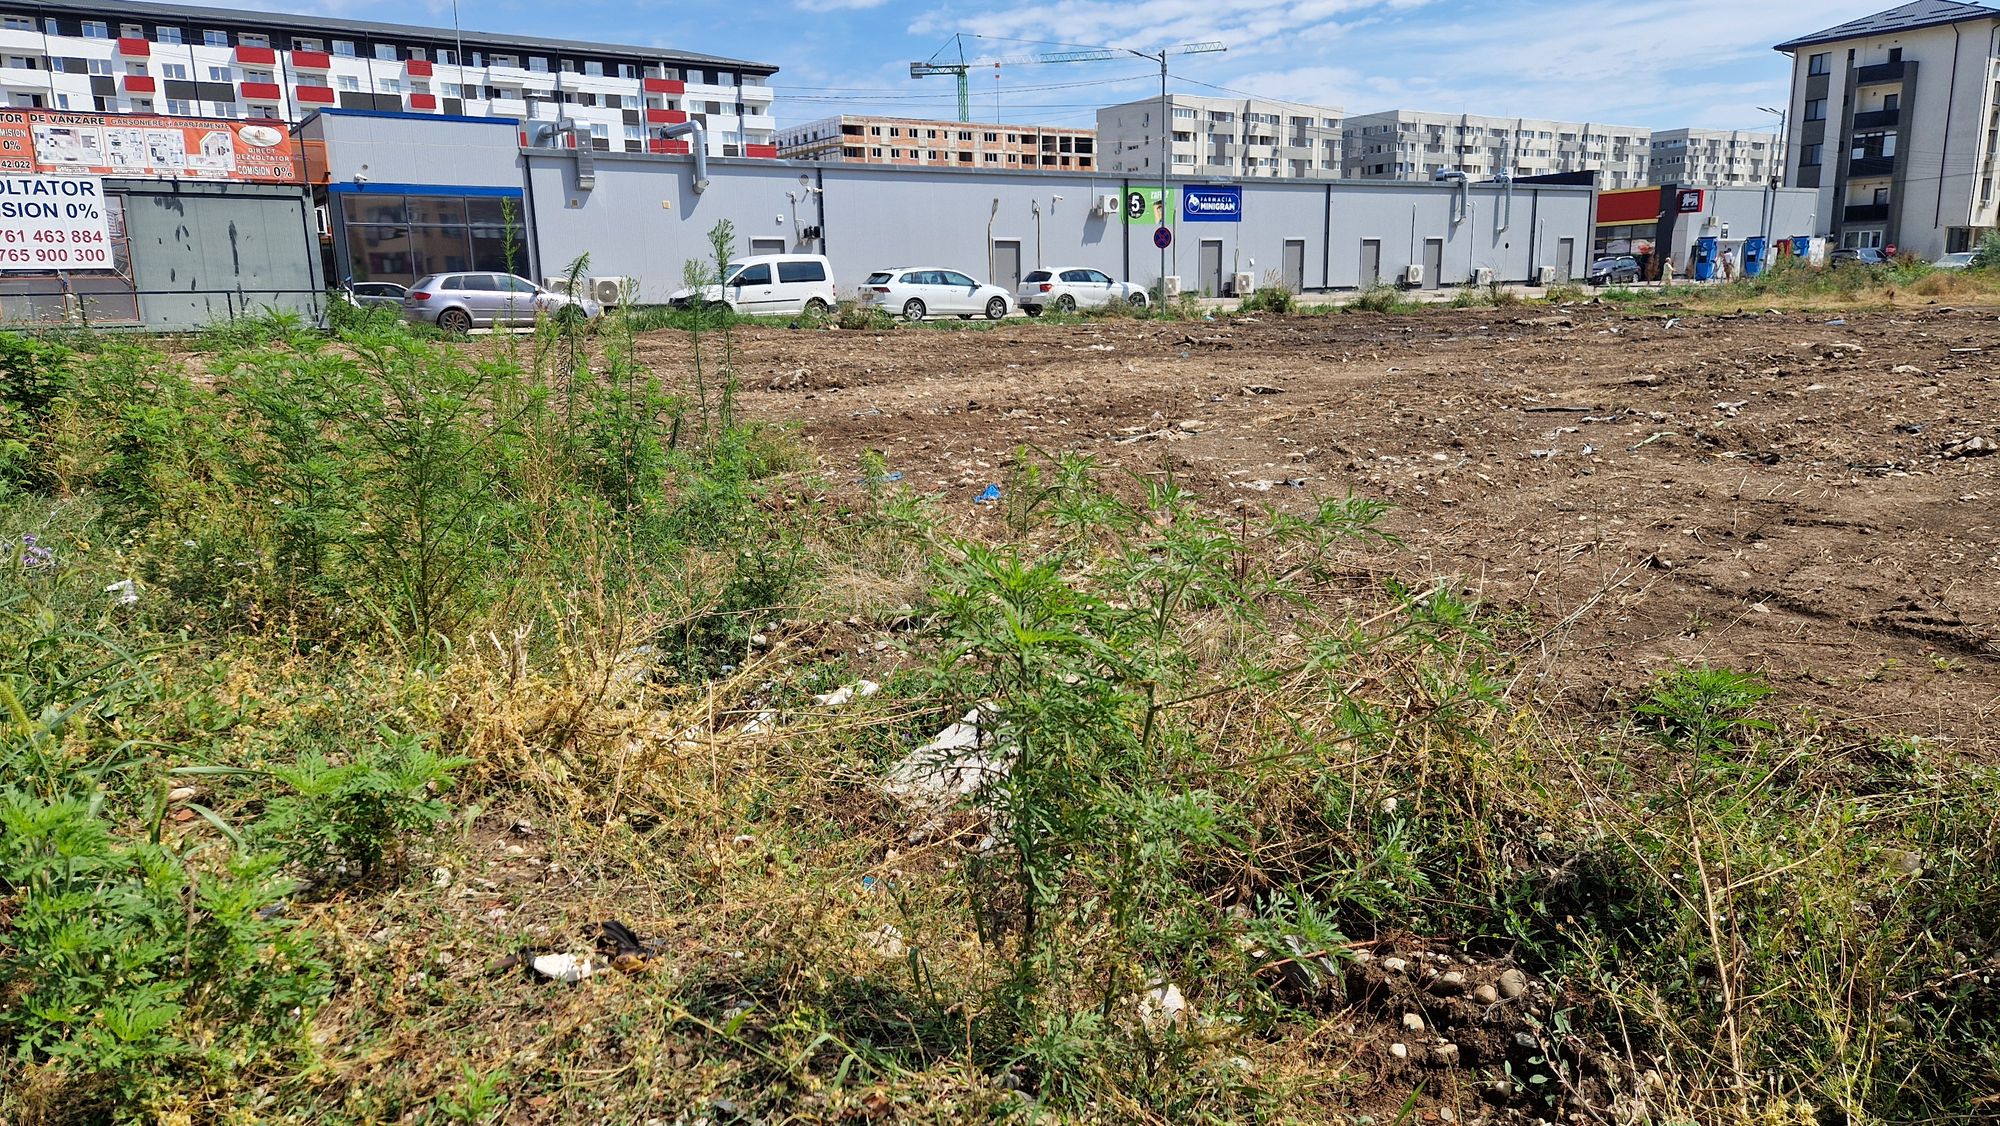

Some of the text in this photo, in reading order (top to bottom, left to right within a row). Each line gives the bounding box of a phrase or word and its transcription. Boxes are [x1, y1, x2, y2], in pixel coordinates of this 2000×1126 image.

[30, 114, 105, 125] DE VANZARE
[111, 118, 163, 127] GARSONIERE
[173, 121, 230, 130] APARTAMENTE
[3, 140, 21, 151] 0%
[236, 154, 290, 162] DEZVOLTATOR
[237, 165, 271, 176] COMISION
[273, 166, 293, 178] 0%
[0, 179, 96, 197] LTATOR
[1131, 195, 1140, 211] 5
[66, 203, 99, 219] 0%
[33, 229, 65, 243] 463
[71, 230, 103, 243] 884
[0, 249, 105, 262] 765 900 300
